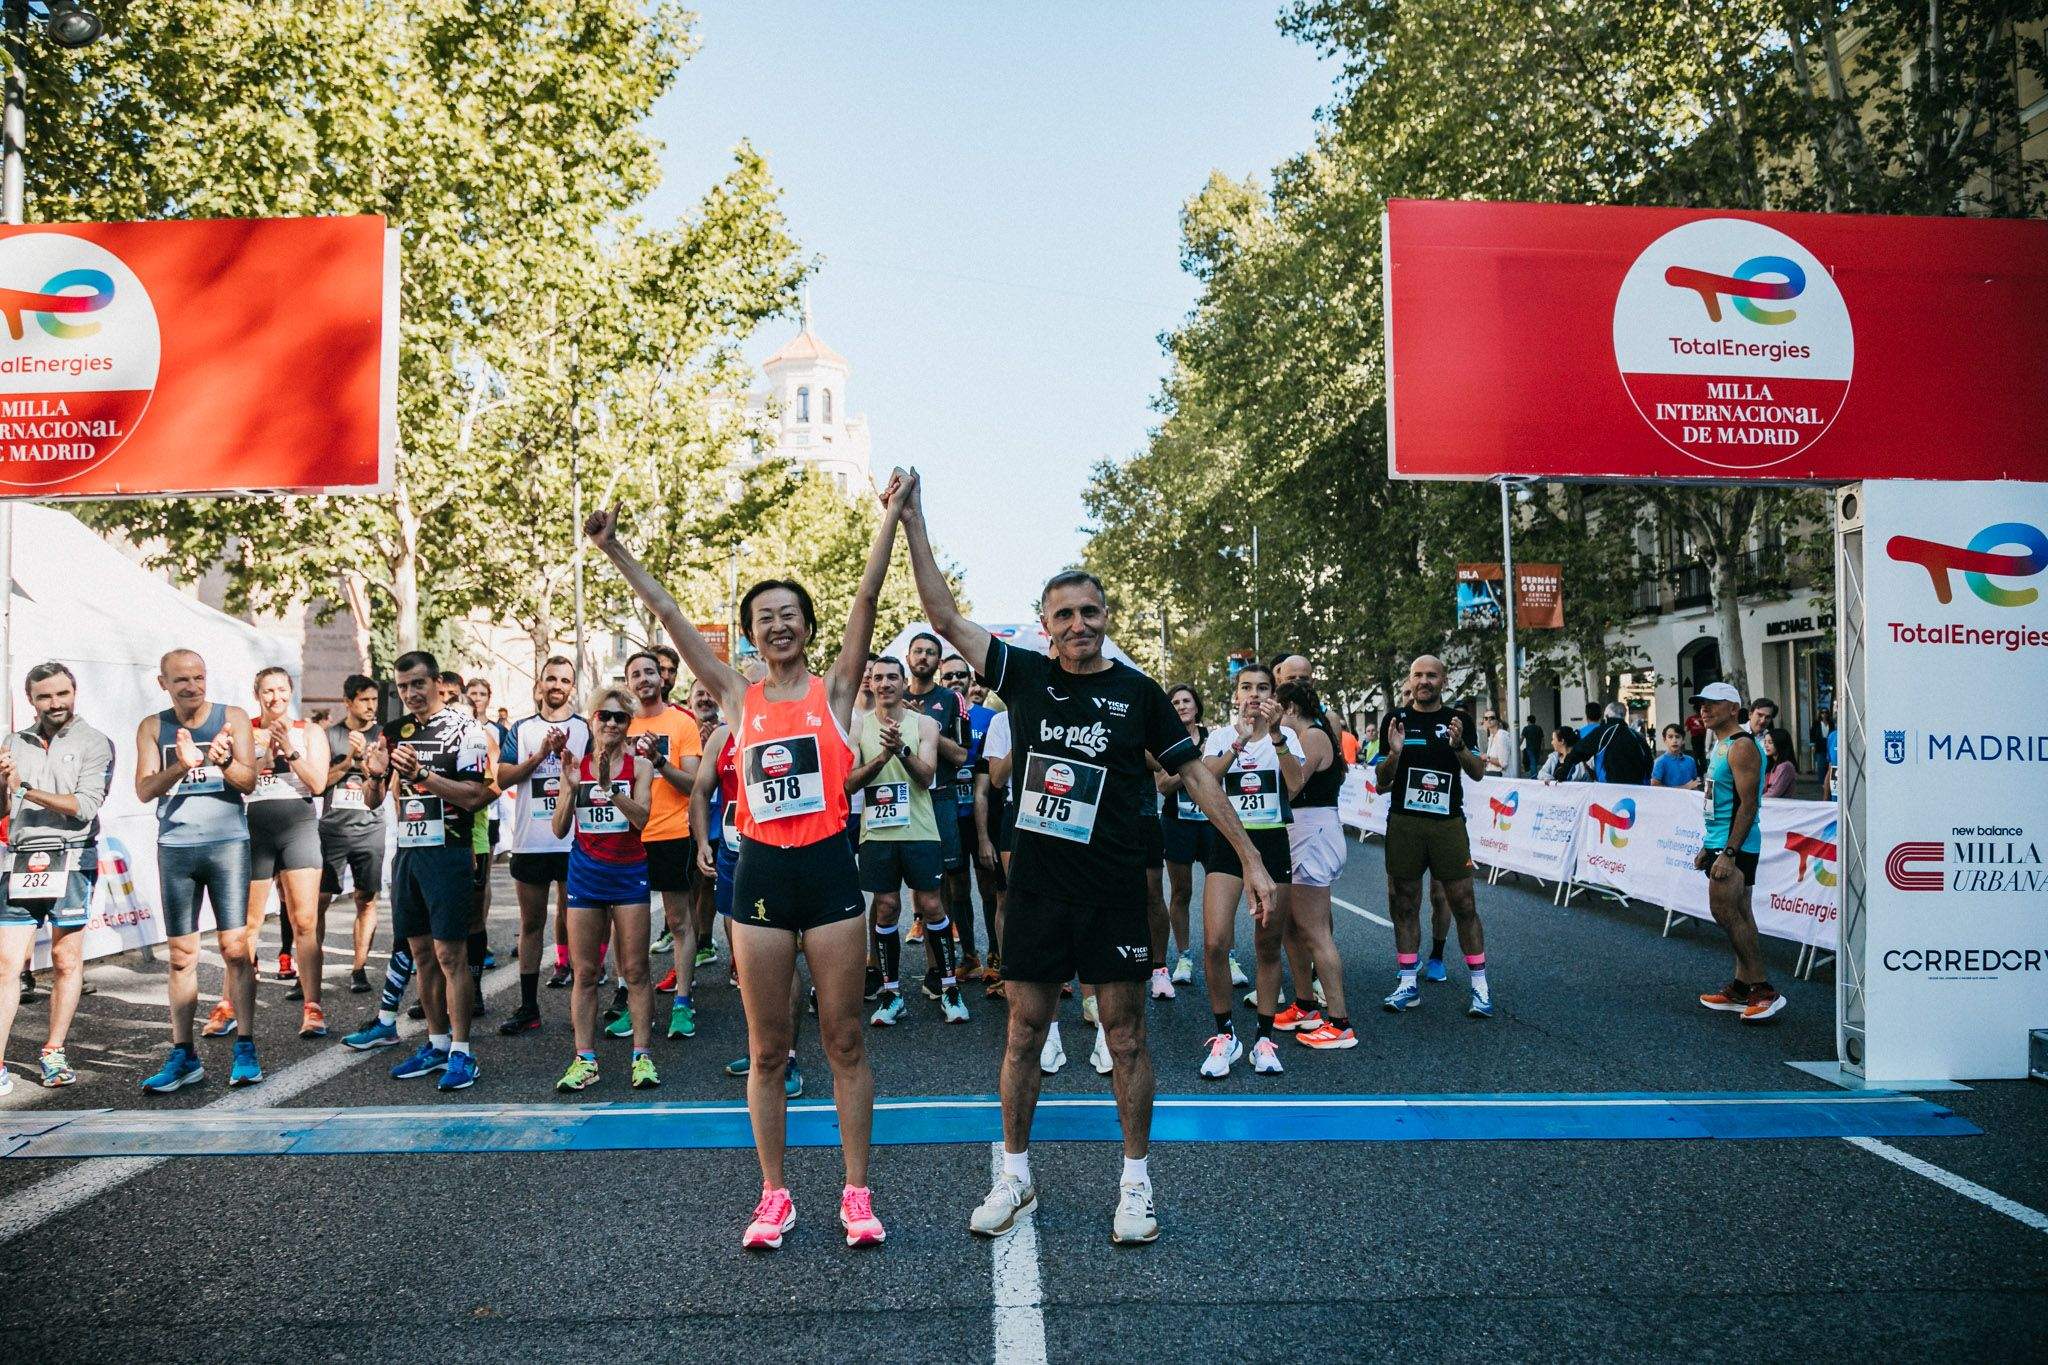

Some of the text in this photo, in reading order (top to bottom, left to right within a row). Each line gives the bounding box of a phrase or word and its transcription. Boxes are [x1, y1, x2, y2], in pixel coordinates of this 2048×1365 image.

[1668, 337, 1811, 362] TotalEnergies
[0, 353, 114, 376] alEnergies
[1706, 382, 1774, 401] MILLA
[0, 398, 71, 418] MILLA
[1682, 426, 1800, 446] DE MADRID
[8, 443, 97, 462] MADRID
[1458, 570, 1480, 580] ISLA
[1766, 612, 1837, 636] MICHAEL KO
[1887, 622, 2048, 652] TotalEnergies
[1107, 700, 1130, 709] VICKY
[1040, 718, 1109, 754] be plus
[762, 776, 801, 804] 578
[1416, 790, 1441, 805] 203
[542, 797, 557, 811] 19
[874, 804, 898, 819] 225
[1035, 794, 1072, 822] 475
[1240, 794, 1265, 810] 231
[588, 807, 614, 823] 185
[406, 822, 428, 837] 212
[1952, 825, 2023, 837] new balance
[1953, 842, 2043, 864] MILLA
[22, 873, 51, 888] 232
[1770, 893, 1838, 923] TotalEnergie
